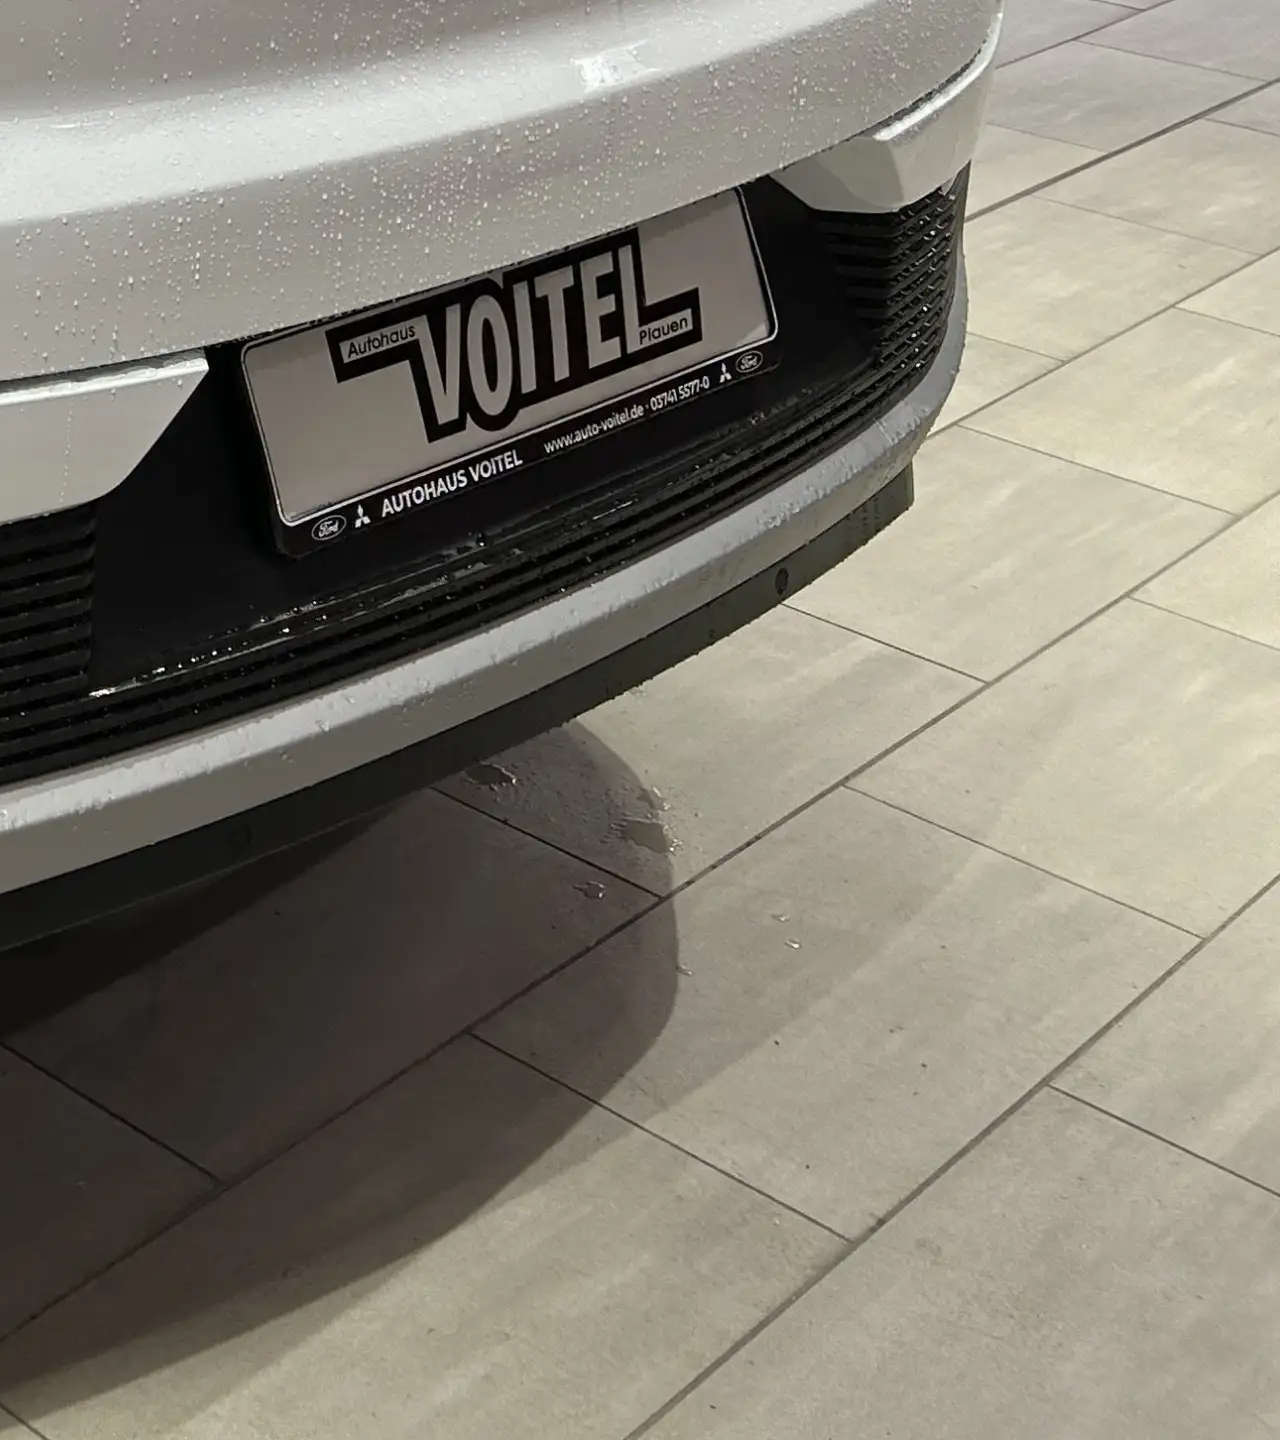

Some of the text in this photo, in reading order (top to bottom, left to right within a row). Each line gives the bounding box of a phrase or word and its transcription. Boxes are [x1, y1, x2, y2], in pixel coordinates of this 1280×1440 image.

[347, 325, 416, 359] Autohaus
[415, 243, 650, 427] VOITEL
[639, 315, 689, 345] Plauen
[381, 469, 468, 518] AUTOHAUS
[468, 448, 523, 483] VOITEL
[543, 403, 644, 454] www.auto-voitel.de
[649, 388, 677, 411] 03741
[678, 375, 710, 400] 5577-0
